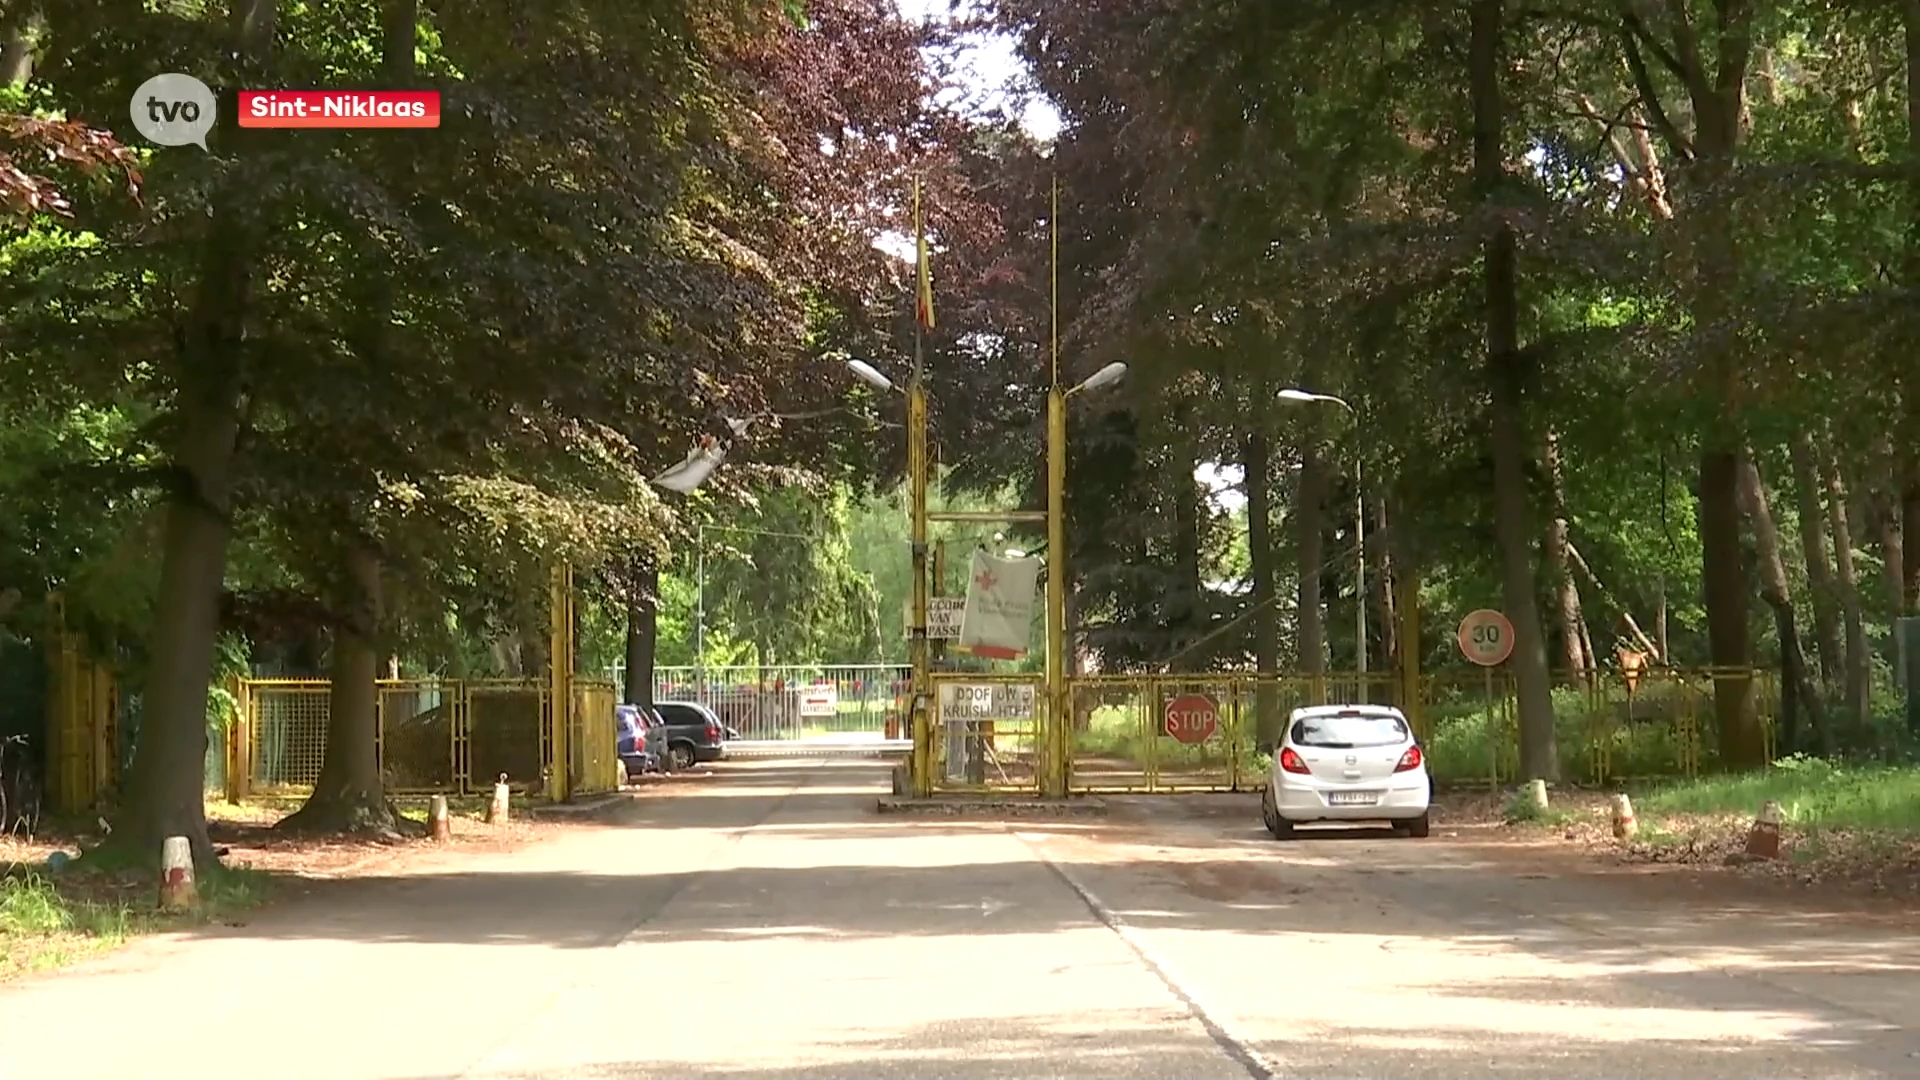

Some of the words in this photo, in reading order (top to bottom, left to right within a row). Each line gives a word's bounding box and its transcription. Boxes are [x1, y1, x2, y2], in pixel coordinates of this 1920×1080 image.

[929, 612, 952, 623] VAN
[1472, 624, 1500, 644] 30
[1168, 710, 1214, 731] STOP
